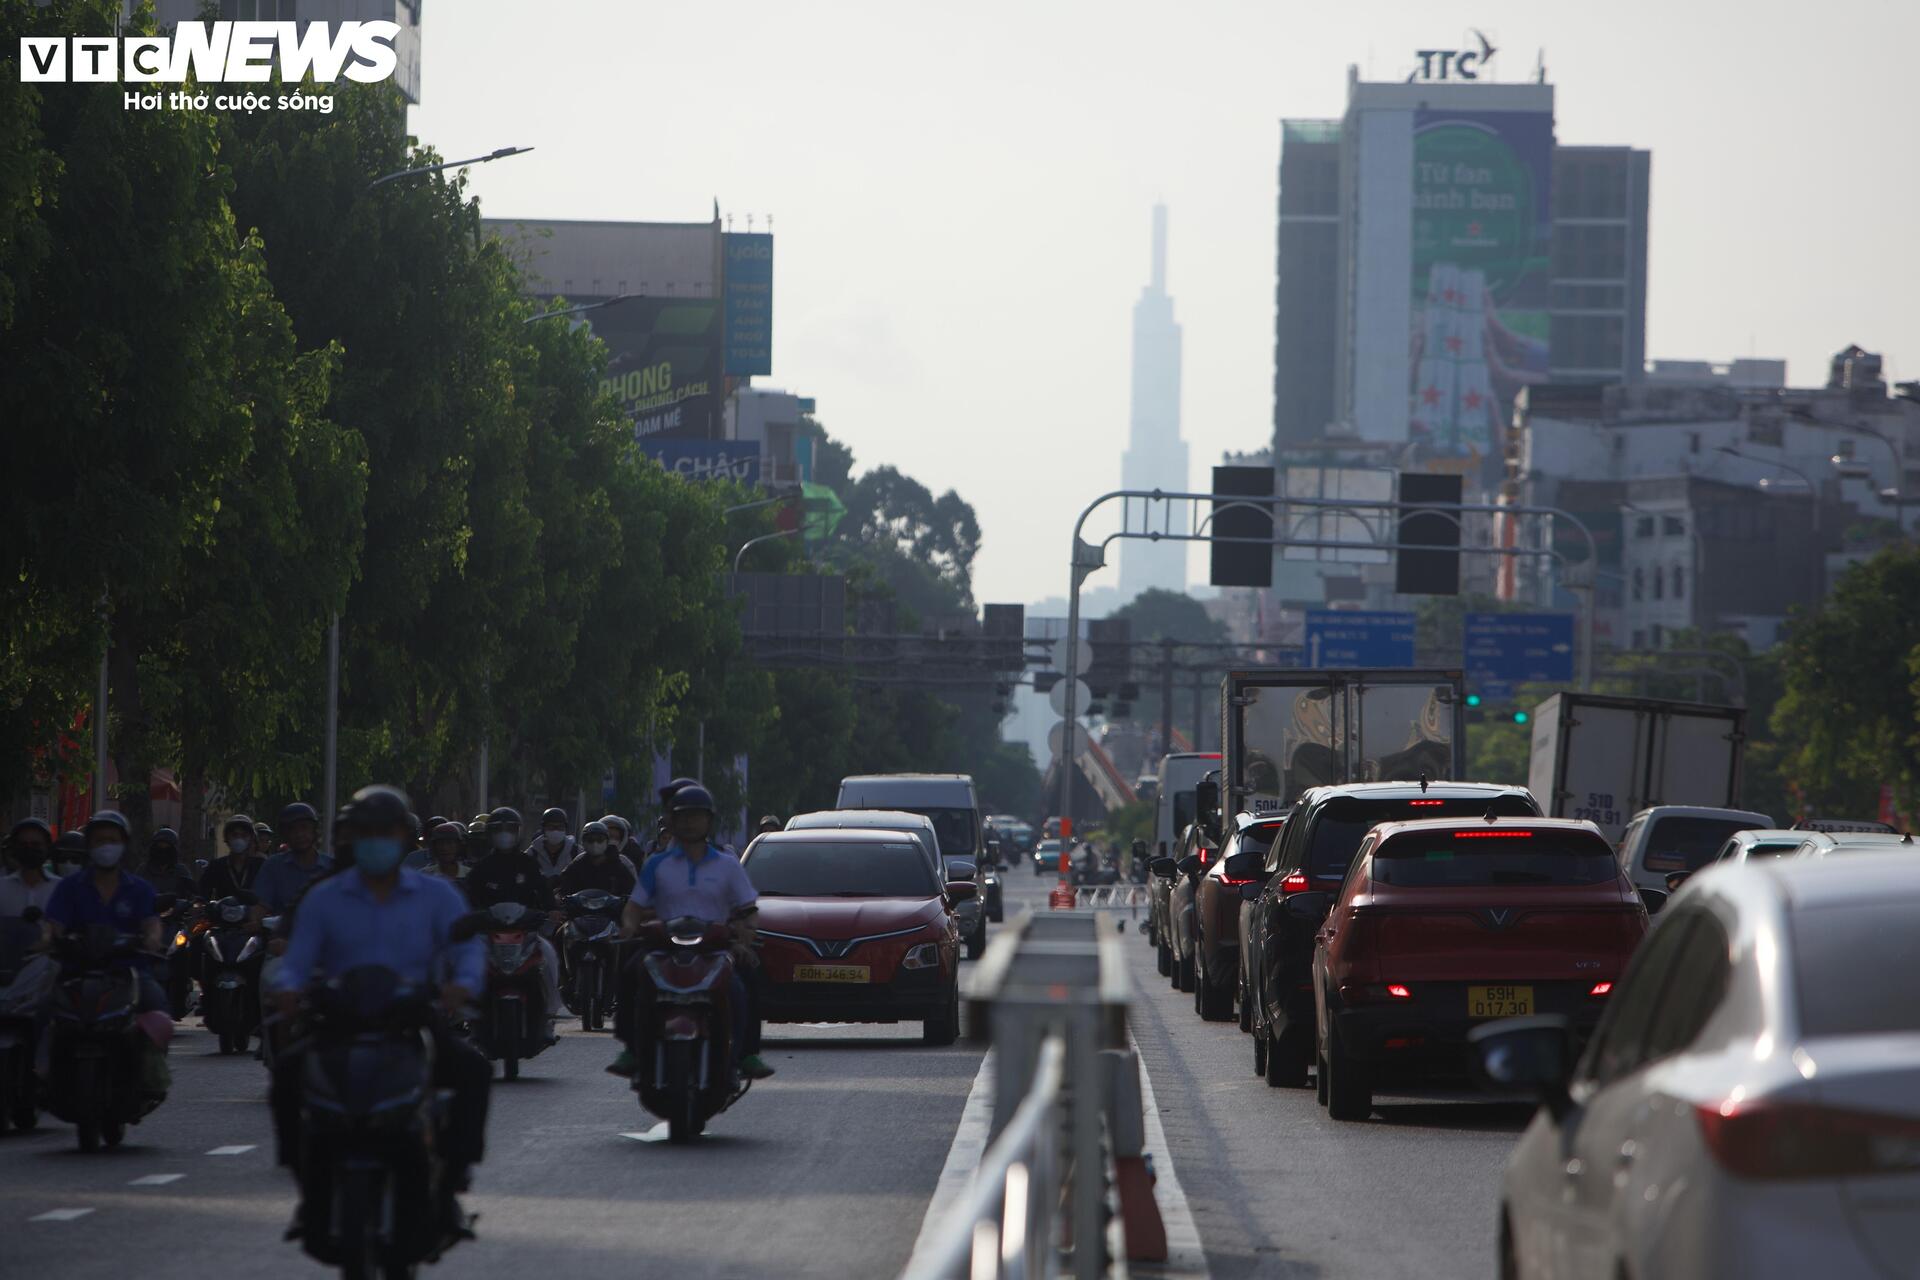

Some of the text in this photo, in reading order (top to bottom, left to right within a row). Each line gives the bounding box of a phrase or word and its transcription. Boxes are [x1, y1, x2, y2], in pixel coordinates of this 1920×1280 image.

[1416, 51, 1477, 80] TTC
[674, 451, 751, 481] CHÂU
[1486, 987, 1516, 1001] 69H
[1475, 1001, 1528, 1016] 017.30
